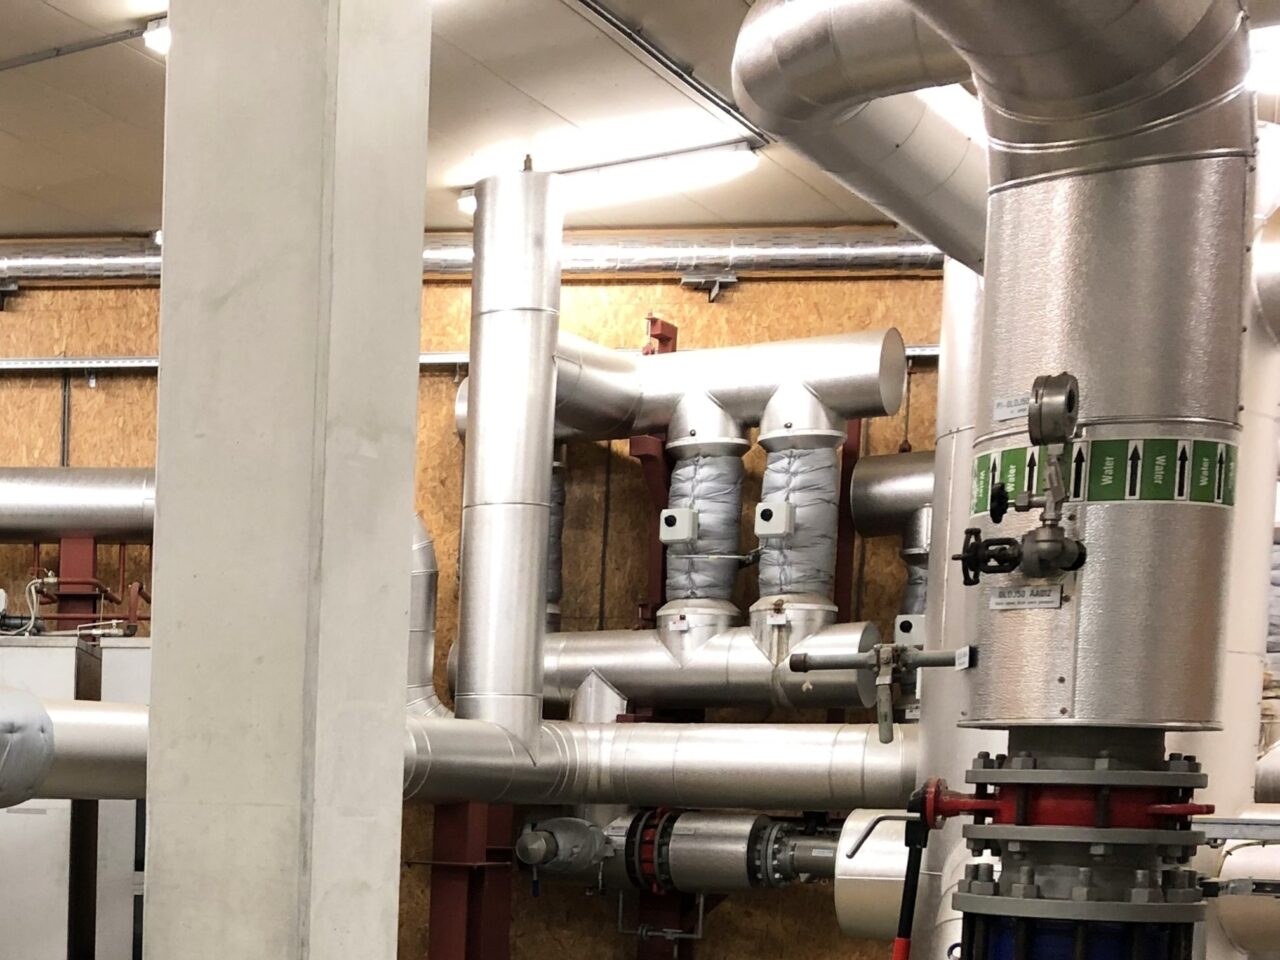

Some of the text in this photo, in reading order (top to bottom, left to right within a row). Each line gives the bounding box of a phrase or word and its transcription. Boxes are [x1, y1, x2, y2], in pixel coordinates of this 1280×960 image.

[1005, 464, 1017, 493] Water
[1101, 456, 1115, 486] Water
[1153, 455, 1167, 484] Water
[1199, 457, 1209, 486] Water
